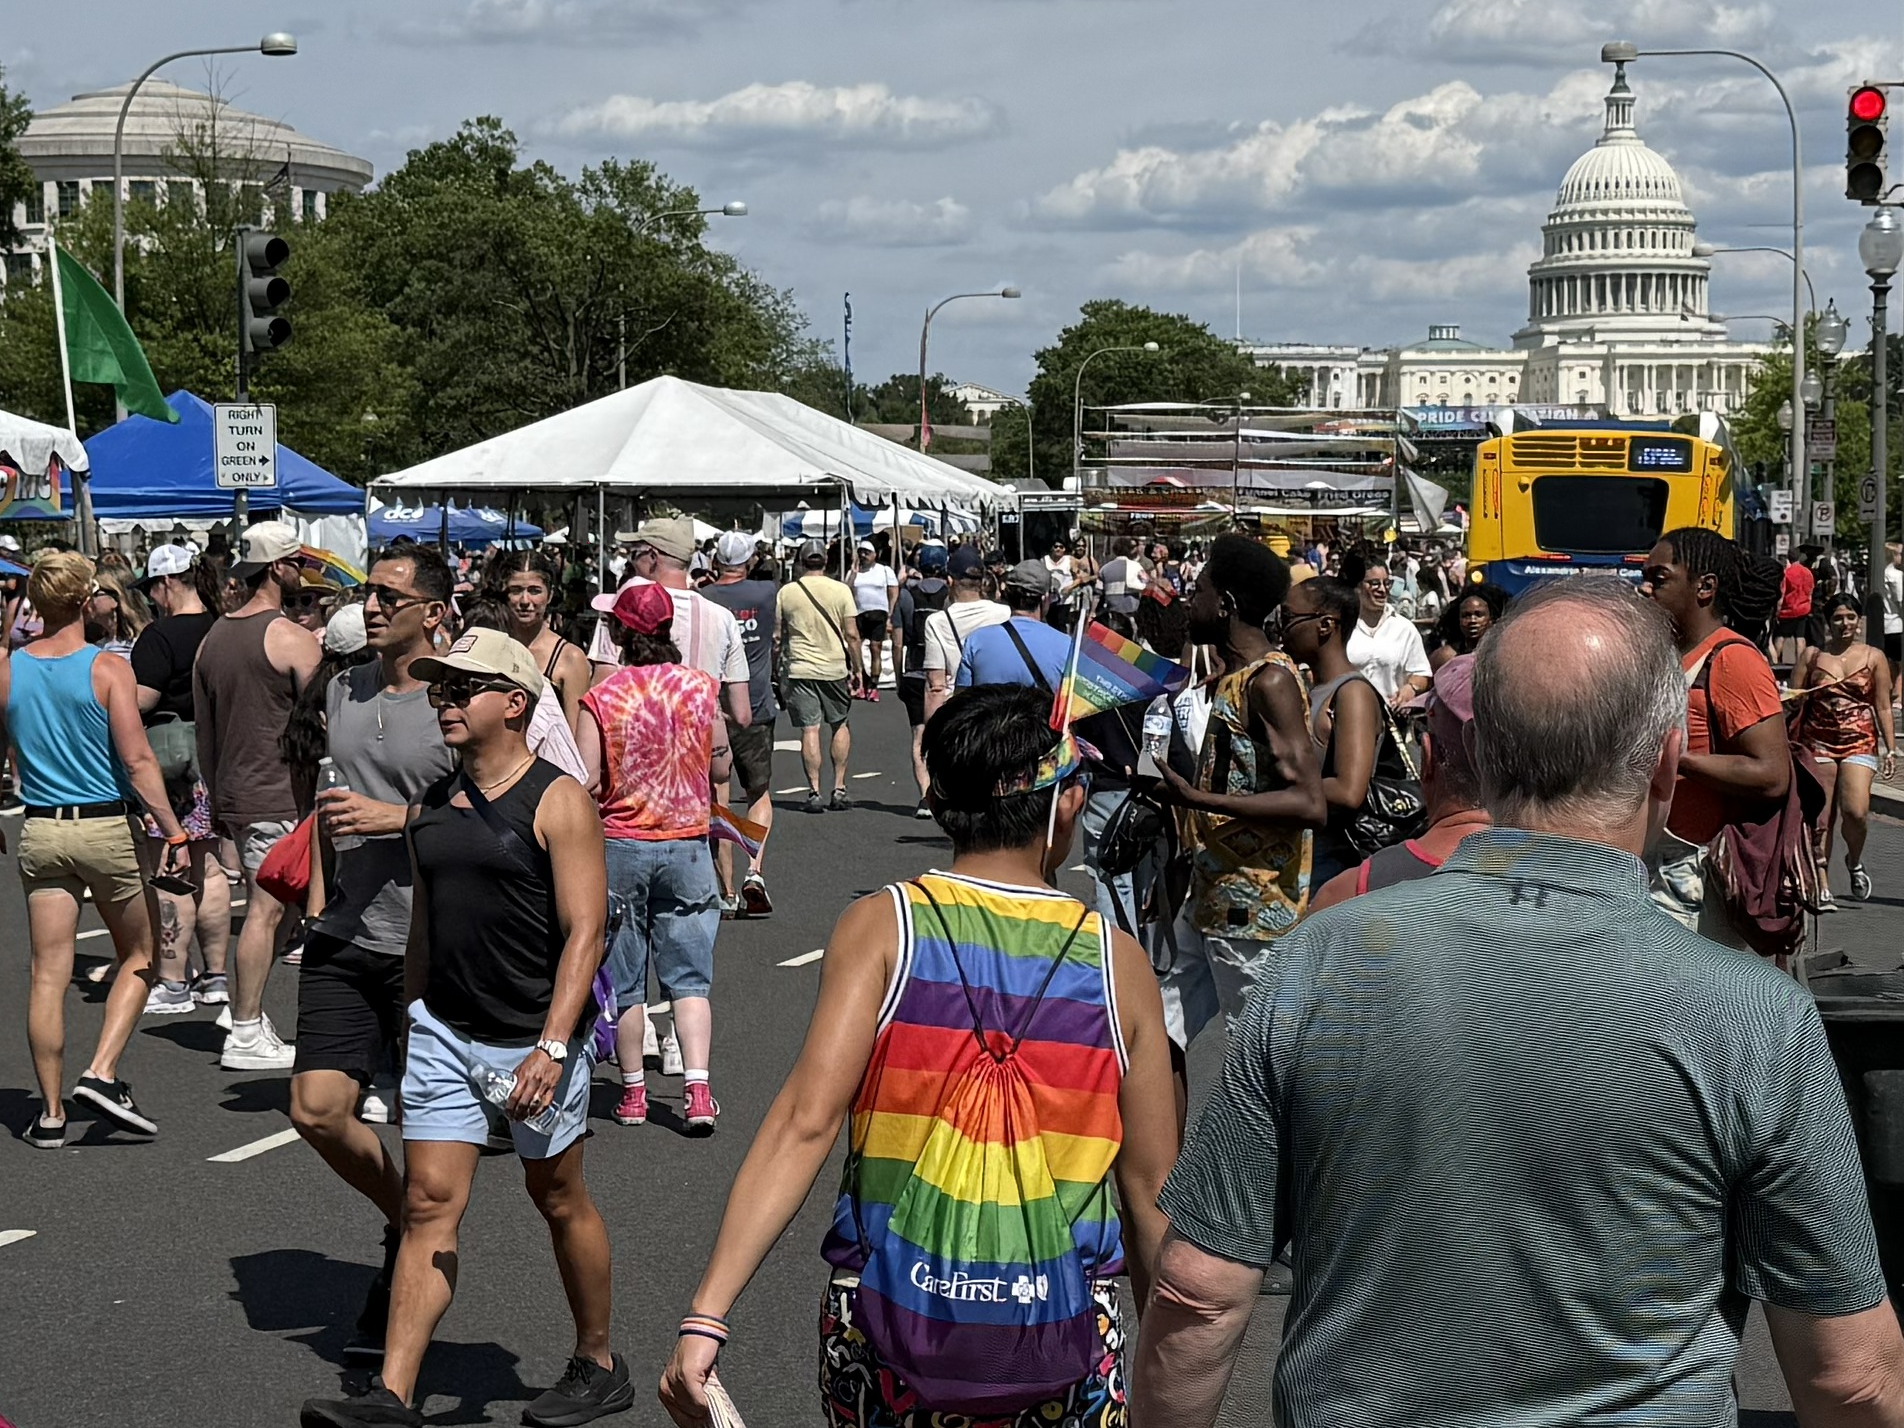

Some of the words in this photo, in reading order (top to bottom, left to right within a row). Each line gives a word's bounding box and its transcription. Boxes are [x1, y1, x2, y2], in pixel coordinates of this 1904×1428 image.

[228, 409, 263, 420] RIGHT
[1418, 409, 1465, 424] PRIDE
[228, 425, 263, 436] TURN
[236, 441, 256, 452] ON
[221, 455, 256, 466] GREEN
[232, 472, 261, 482] ONLY
[910, 1261, 1008, 1303] CareFirst
